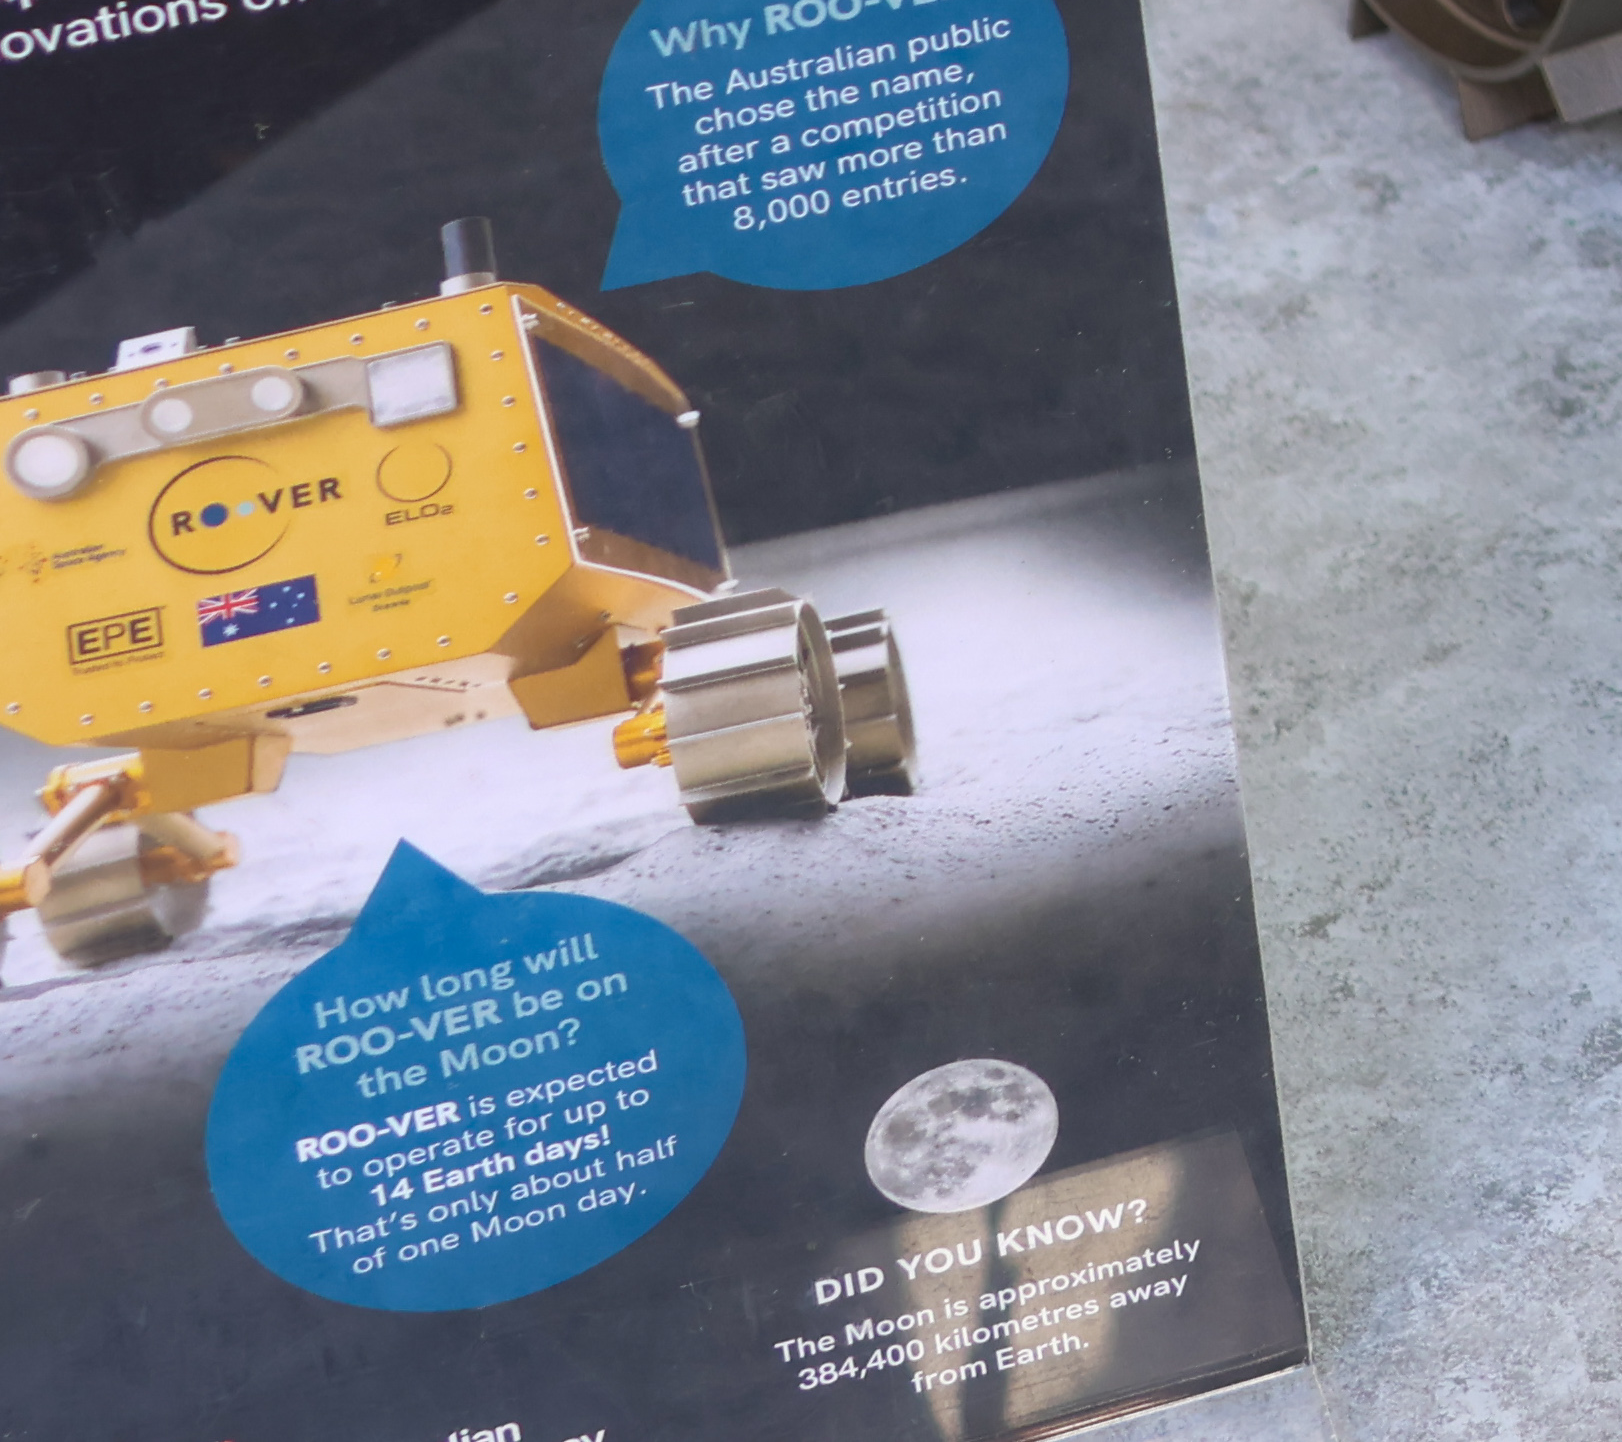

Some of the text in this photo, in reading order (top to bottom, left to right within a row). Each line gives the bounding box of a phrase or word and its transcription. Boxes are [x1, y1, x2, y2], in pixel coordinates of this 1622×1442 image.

[645, 17, 1011, 109] The Australian public
[650, 18, 751, 57] Why
[678, 90, 1001, 173] after a competition
[695, 65, 974, 135] chose the name,
[682, 123, 1006, 207] that saw more than
[734, 169, 967, 231] 8,000 entries.
[77, 616, 154, 655] EPE
[295, 973, 627, 1074] ROO-VER be on
[314, 933, 599, 1029] How long will
[356, 1018, 580, 1098] the Moon?
[296, 1049, 657, 1162] ROO-VER is expected
[317, 1090, 649, 1189] to operate for up to
[370, 1124, 610, 1206] 14 Earth days!
[428, 1190, 498, 1222] only
[511, 1158, 606, 1201] about
[616, 1135, 677, 1171] half
[353, 1182, 646, 1274] of one Moon day.
[815, 1199, 1146, 1305] DID YOU KNOW?
[774, 1240, 1200, 1362] The Moon is approximately
[798, 1274, 1187, 1390] 384,400 kilometres away
[911, 1333, 1088, 1393] from Earth.
